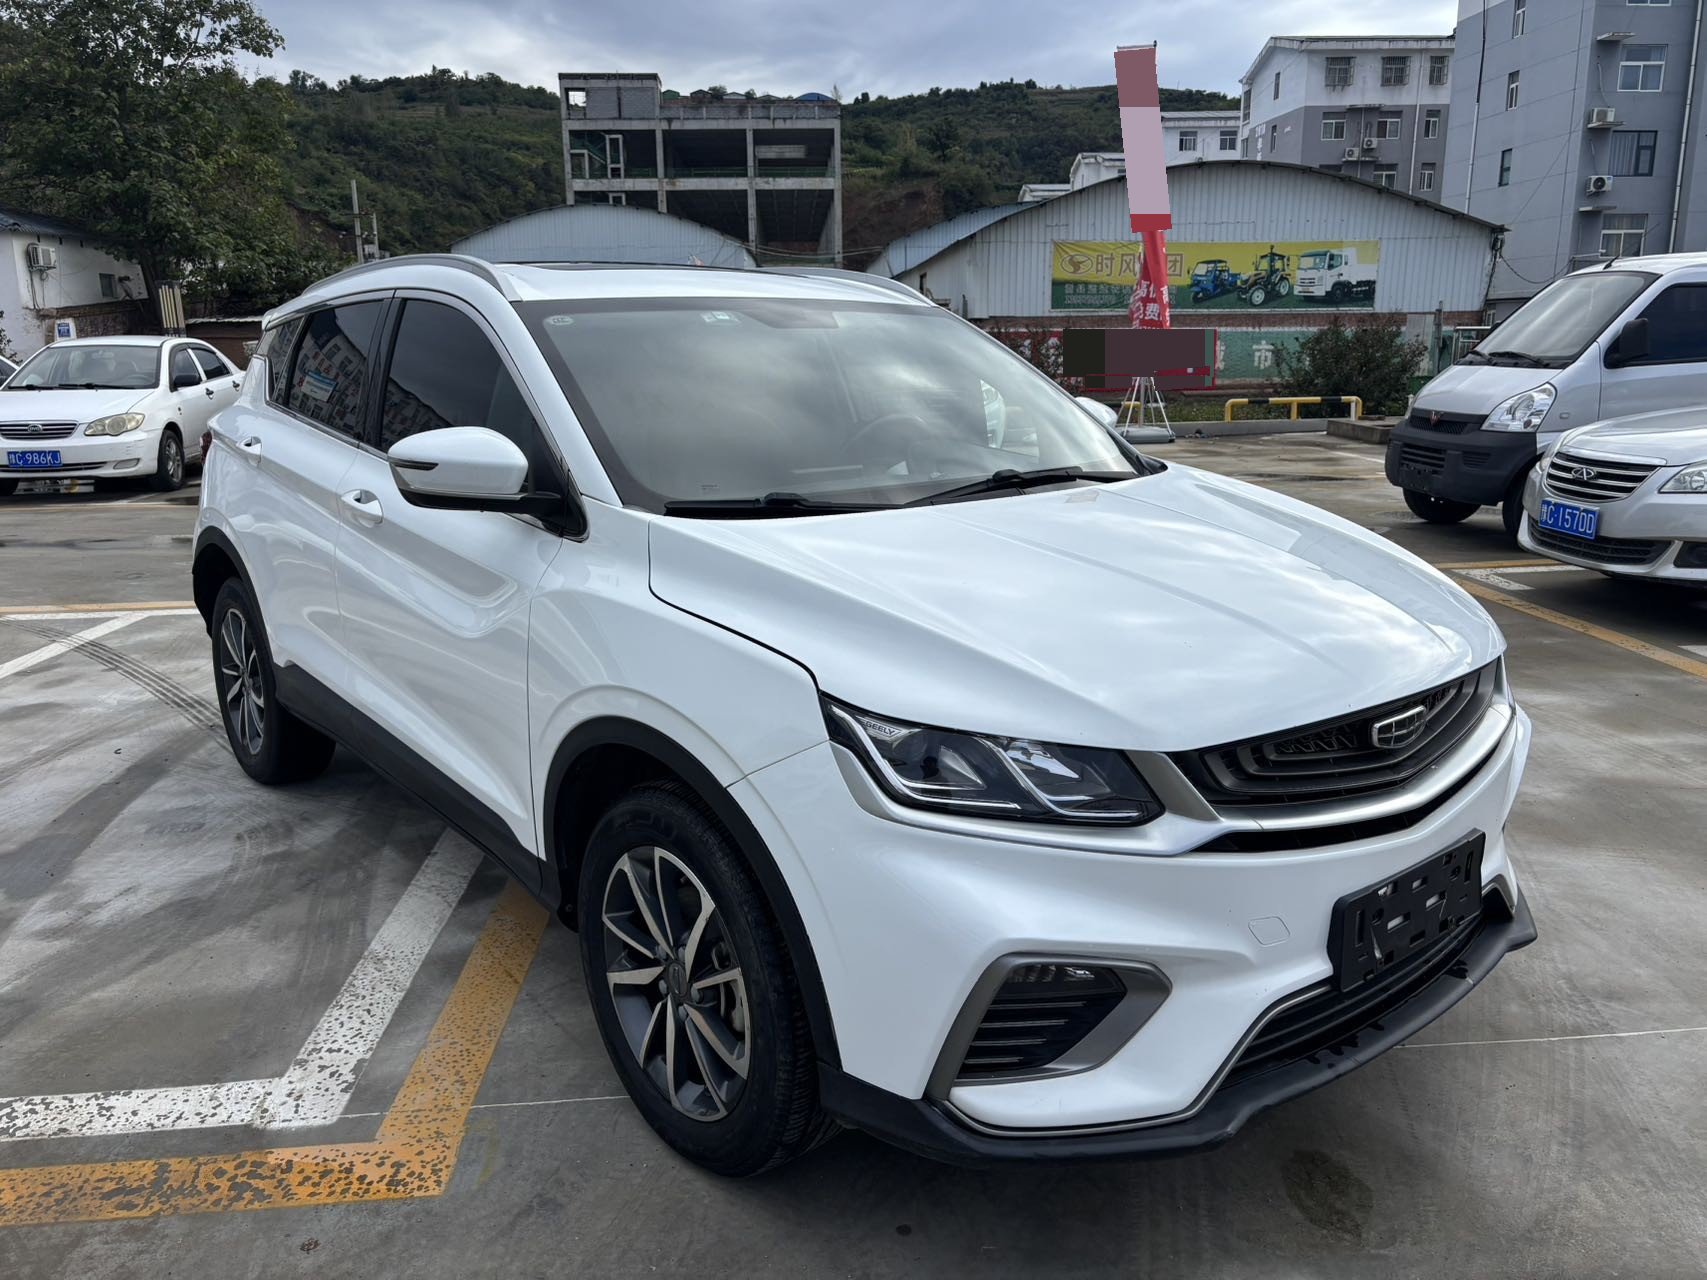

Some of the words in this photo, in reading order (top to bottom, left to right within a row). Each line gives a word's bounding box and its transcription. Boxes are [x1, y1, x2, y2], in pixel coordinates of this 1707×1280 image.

[1095, 253, 1184, 277] 时风团
[865, 720, 896, 736] GEELY
